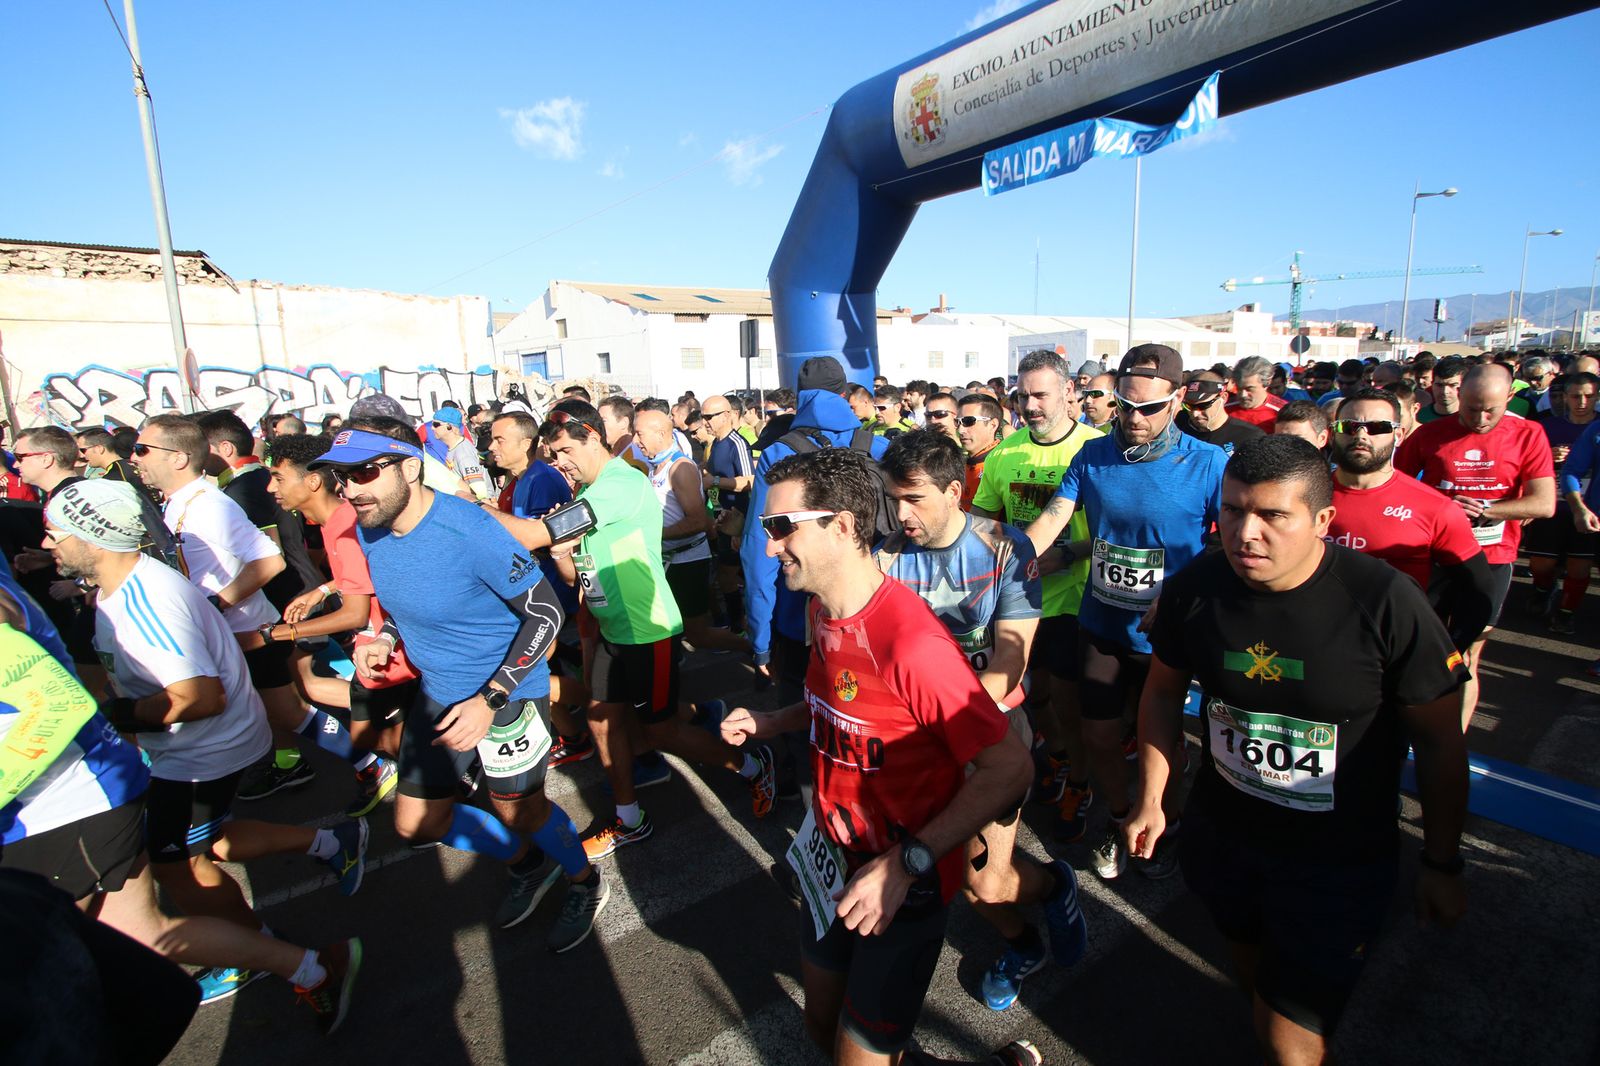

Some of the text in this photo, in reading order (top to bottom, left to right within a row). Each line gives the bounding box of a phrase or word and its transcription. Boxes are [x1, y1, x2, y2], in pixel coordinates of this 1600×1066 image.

[952, 55, 1006, 90] EXCMO.
[953, 74, 1022, 116] Concejalía
[1026, 69, 1044, 91] de
[1049, 37, 1126, 79] Deportes
[1131, 29, 1142, 51] y
[988, 140, 1061, 190] SALIDA
[1382, 504, 1413, 521] edp
[1097, 560, 1157, 589] 1654
[523, 620, 551, 657] LURBEL
[497, 734, 530, 757] 45
[1264, 723, 1306, 739] MARATÓN
[1220, 727, 1324, 778] 1604
[1240, 760, 1291, 782] EDUMAR
[808, 824, 837, 890] 989
